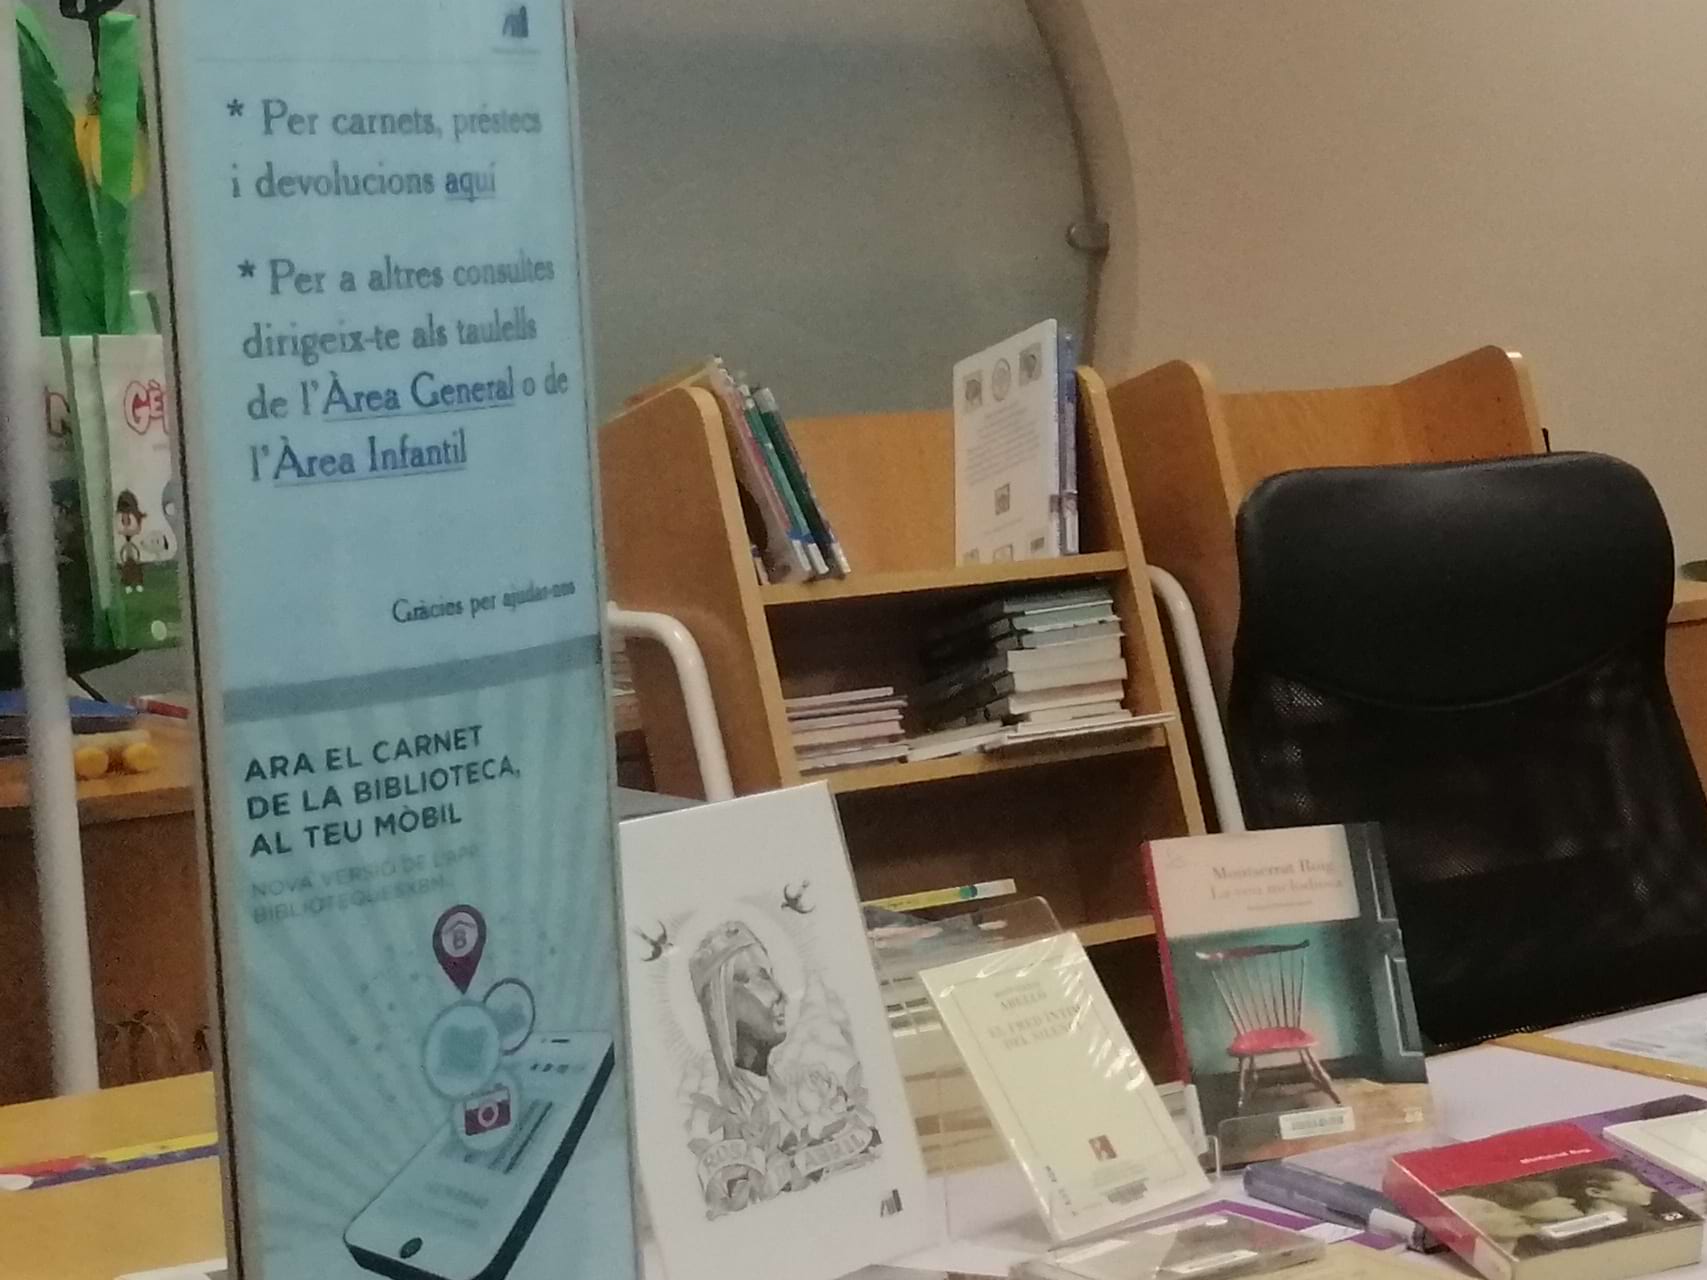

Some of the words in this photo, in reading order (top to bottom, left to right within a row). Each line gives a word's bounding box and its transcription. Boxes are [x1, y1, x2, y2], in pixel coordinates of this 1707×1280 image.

[261, 98, 319, 136] Per
[332, 106, 443, 139] carnets,
[231, 162, 241, 199] i
[255, 160, 435, 198] devolucions
[269, 258, 326, 295] Per
[339, 270, 357, 293] a
[368, 254, 444, 291] altres
[453, 248, 555, 286] consultes
[243, 319, 401, 366] dirigeix-te
[412, 313, 448, 350] als
[456, 305, 537, 346] taulells
[247, 382, 289, 420] de
[301, 371, 401, 417] l'Àrea
[410, 365, 514, 408] General
[522, 375, 536, 398] o
[544, 361, 568, 395] de
[251, 435, 356, 482] l'Àrea
[367, 427, 467, 472] Infantil
[392, 596, 464, 624] Gràcies
[470, 594, 496, 619] per
[244, 753, 315, 783] ARA
[326, 746, 363, 771] EL
[373, 724, 484, 763] CARNET
[247, 792, 290, 821] DE
[303, 785, 343, 812] LA
[250, 828, 293, 858] AL
[304, 820, 362, 849] TEU
[375, 802, 462, 839] MÒBIL
